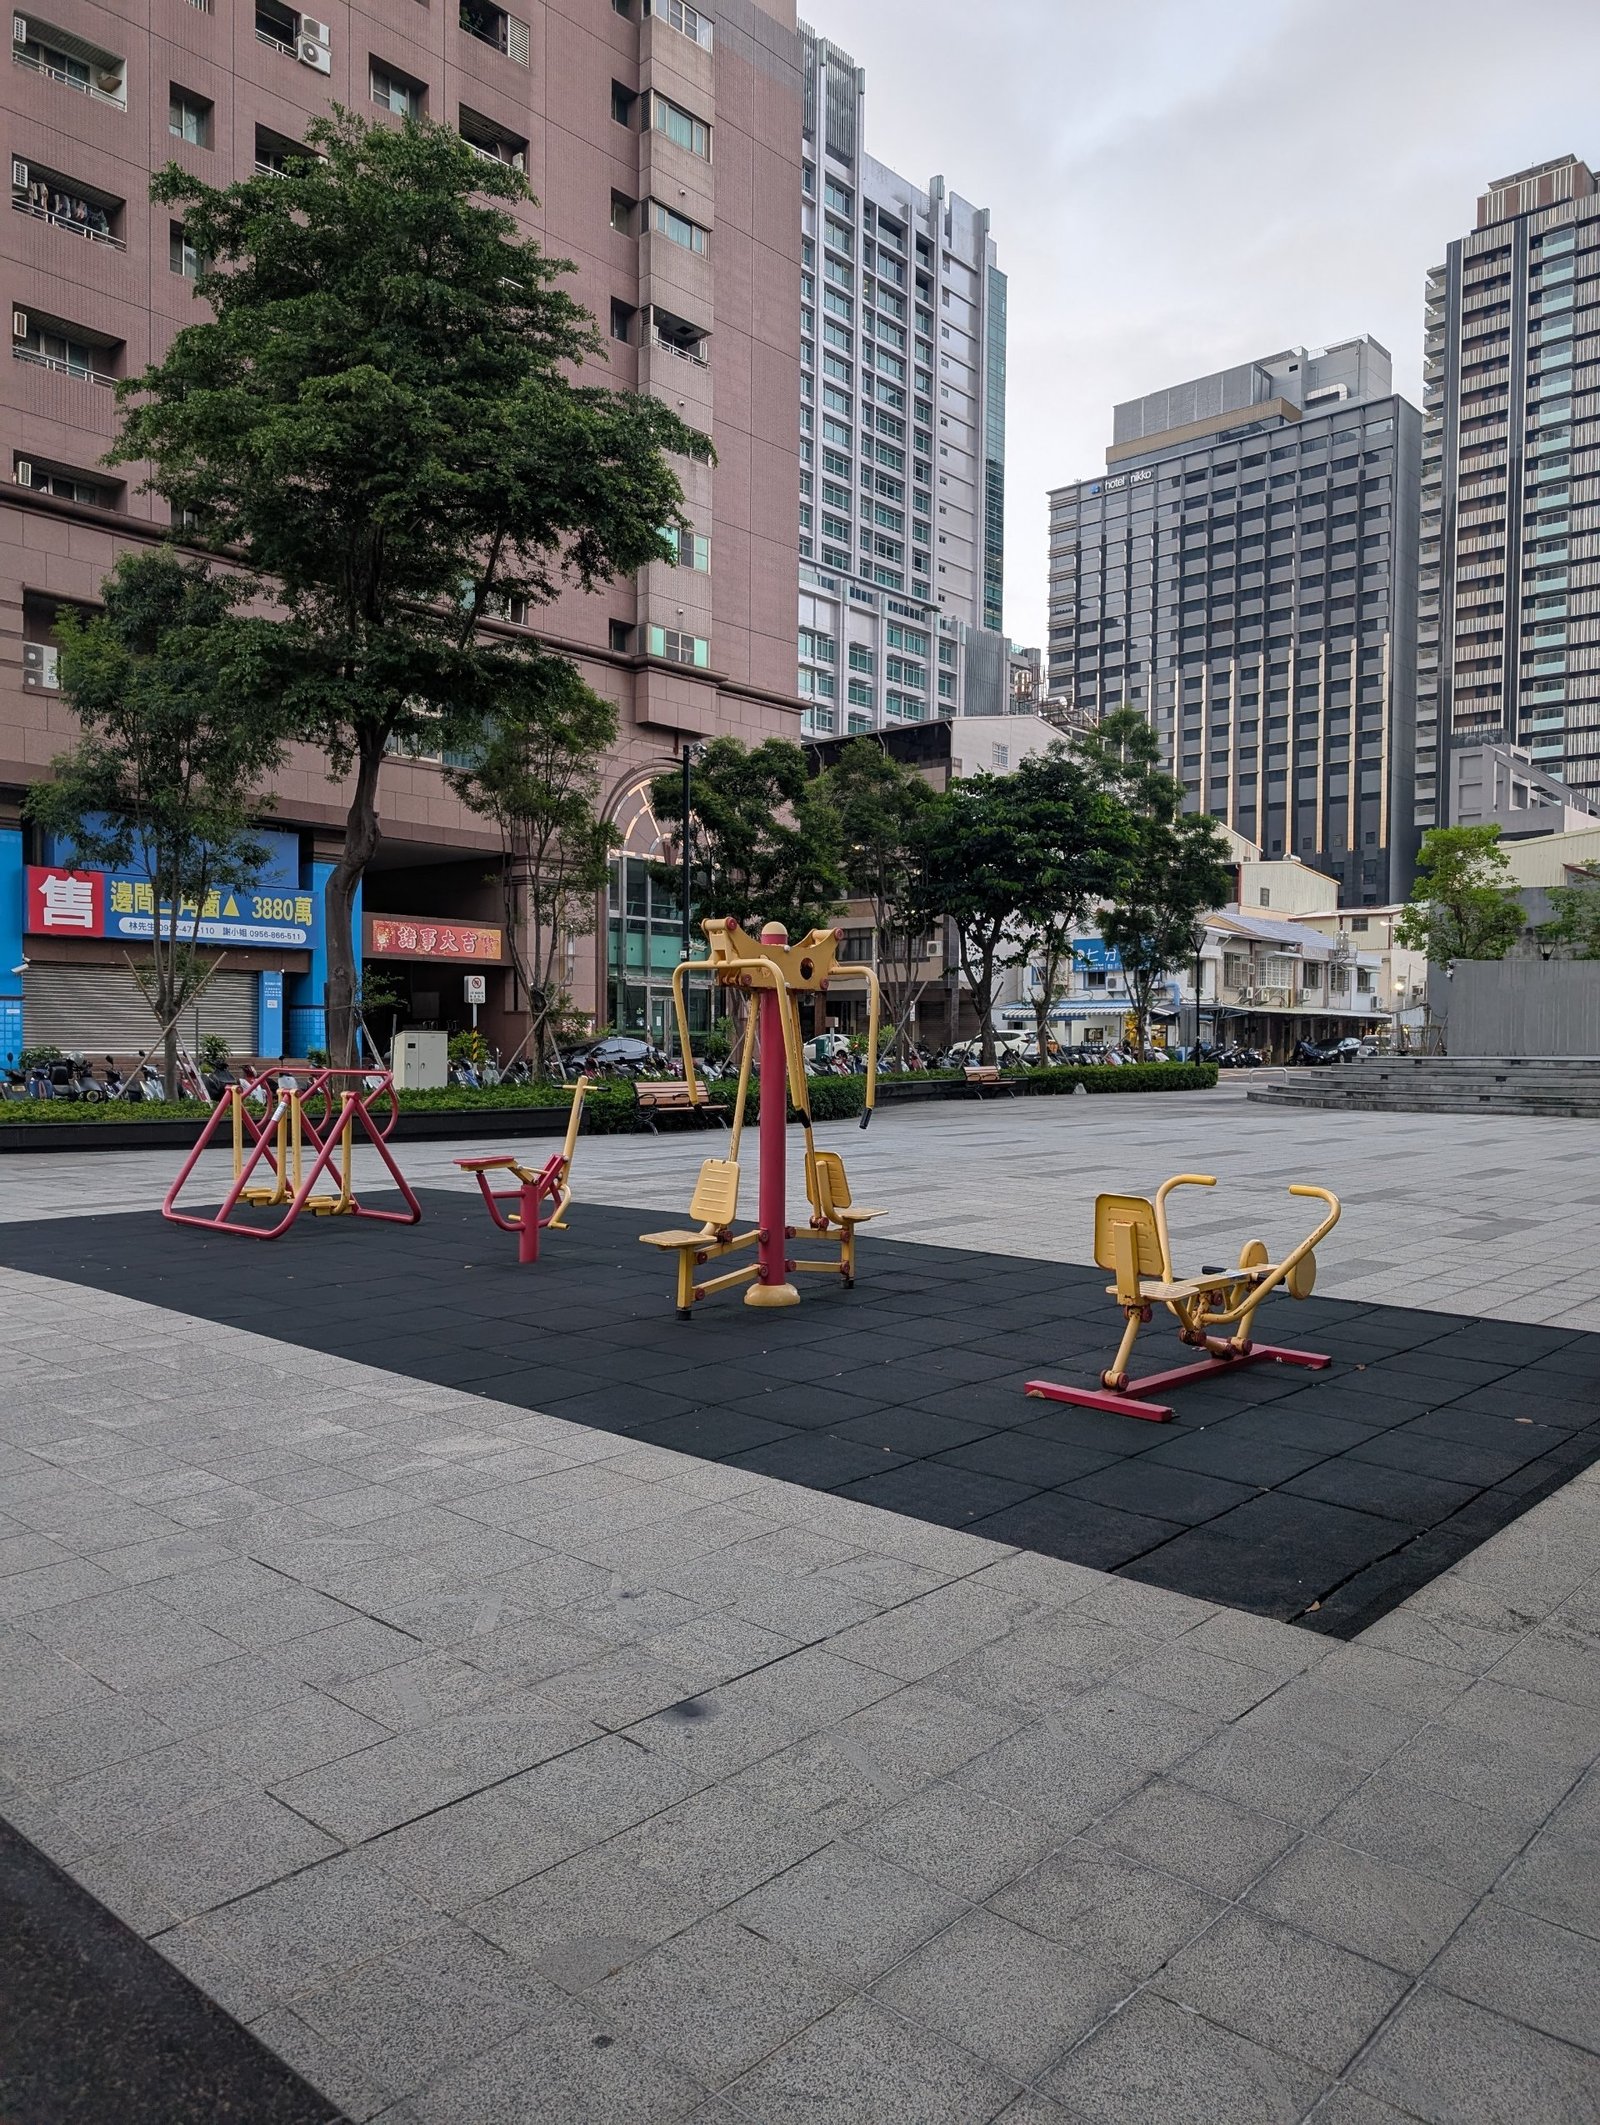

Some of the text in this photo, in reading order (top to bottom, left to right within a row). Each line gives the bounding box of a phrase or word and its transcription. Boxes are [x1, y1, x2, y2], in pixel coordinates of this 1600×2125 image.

[1104, 470, 1152, 490] hotel nikko
[38, 874, 93, 929] 售
[251, 895, 313, 926] 3880萬
[128, 920, 301, 940] 林先生 09-47-110 謝小姐 0956-866-511
[397, 926, 478, 953] 諸事大吉
